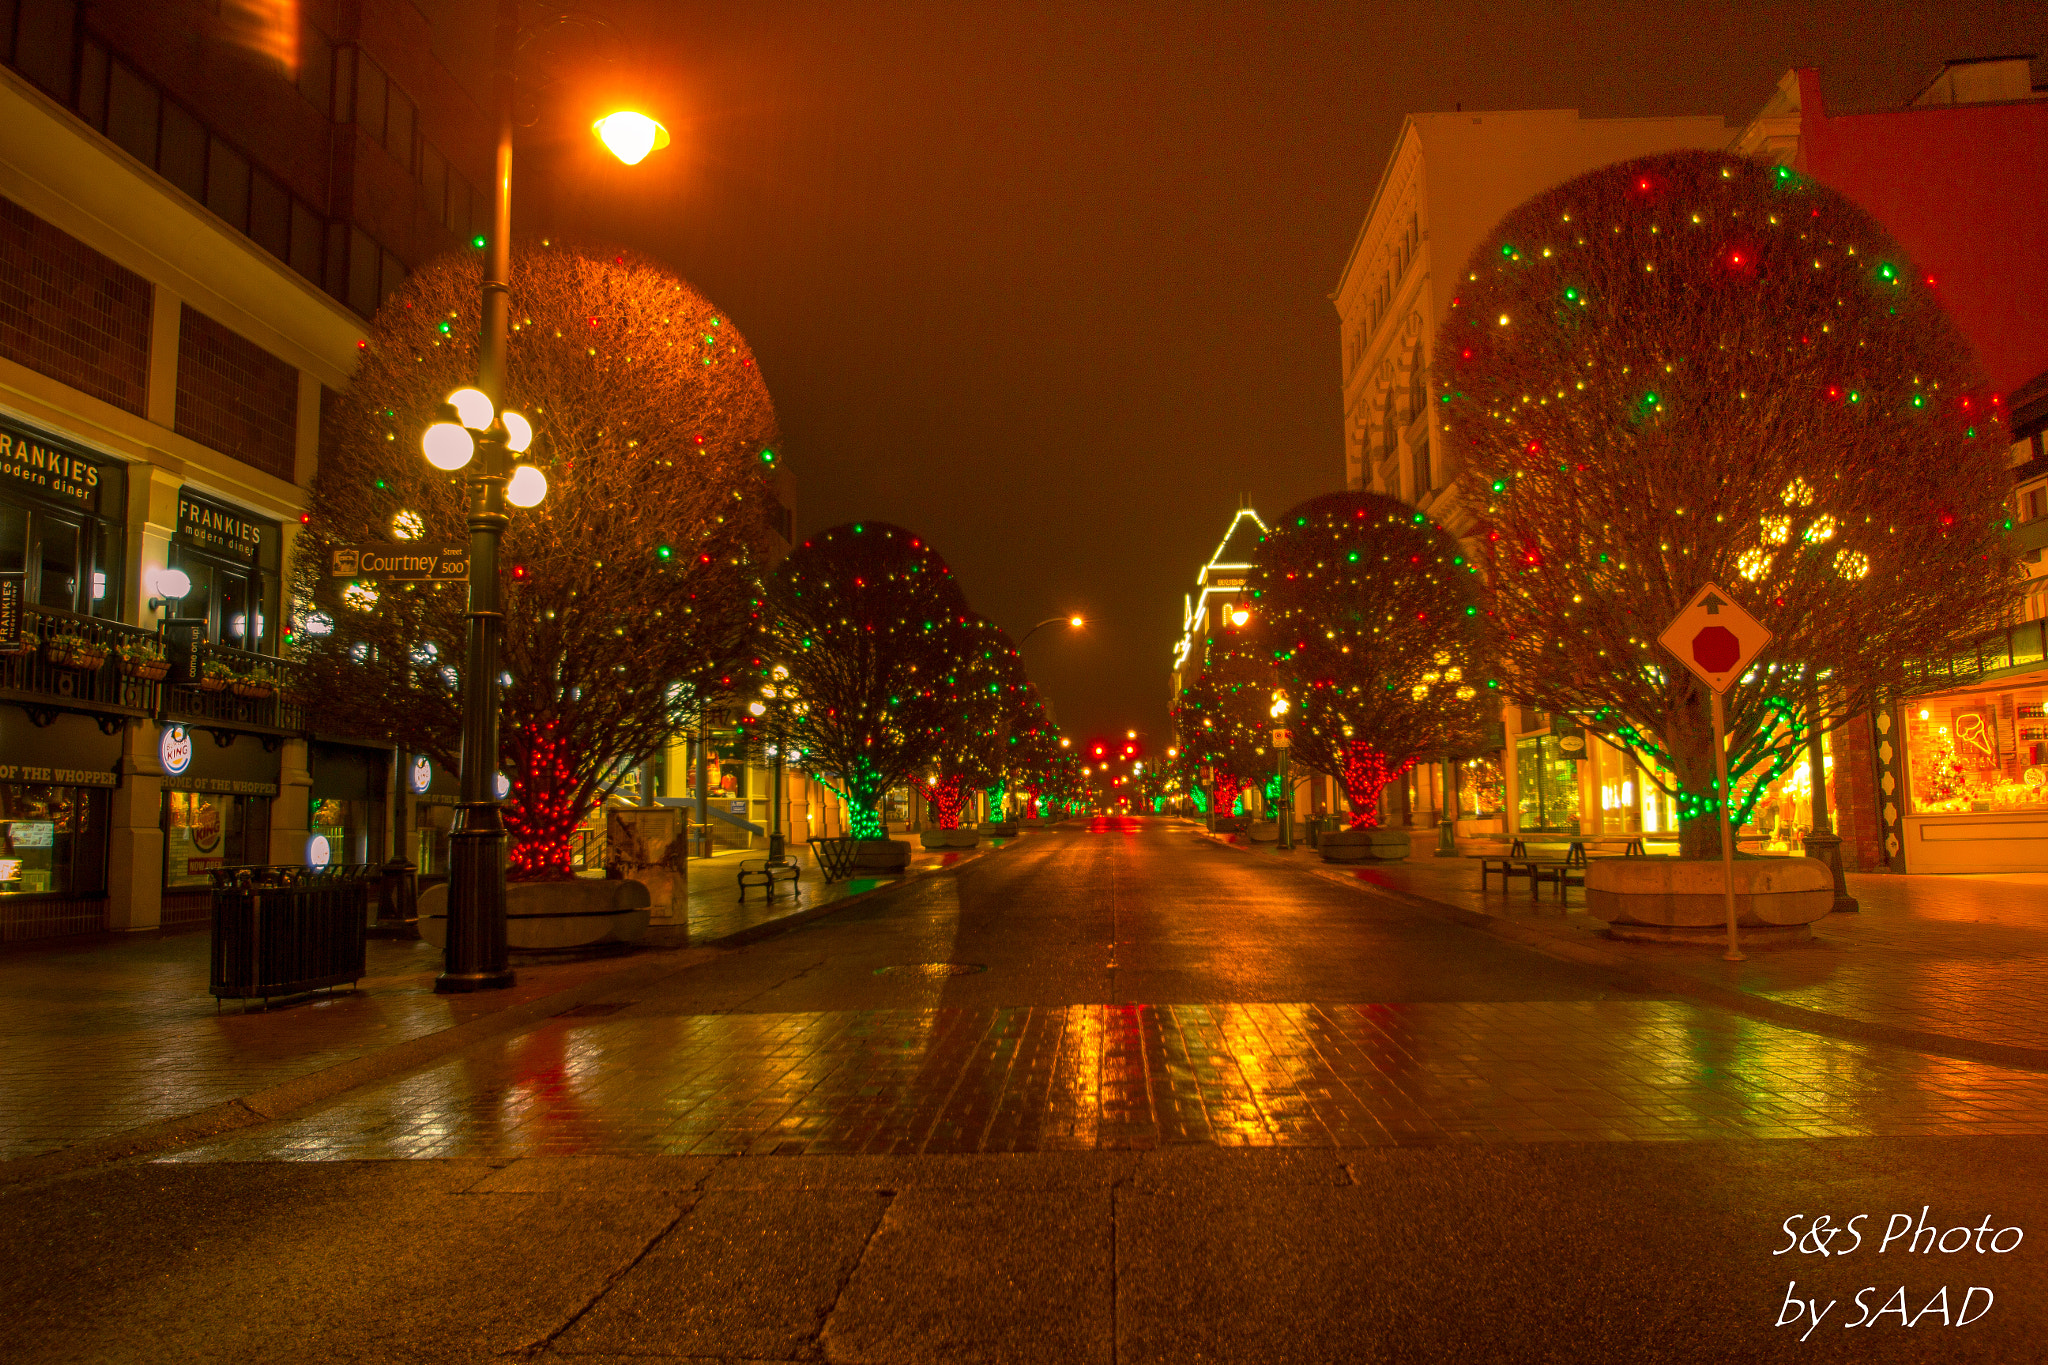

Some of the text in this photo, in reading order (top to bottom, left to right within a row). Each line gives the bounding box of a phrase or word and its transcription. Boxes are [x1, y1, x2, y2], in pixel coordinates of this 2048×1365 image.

[52, 479, 90, 500] diner
[180, 500, 261, 544] FRANKIE'S
[185, 525, 255, 556] modern diner
[443, 547, 463, 556] Street
[361, 552, 439, 574] Courtney
[441, 562, 464, 574] 500
[191, 641, 198, 653] on
[190, 654, 198, 678] come
[167, 744, 189, 761] KING
[0, 765, 117, 785] OF THE WHOPPER
[161, 776, 277, 794] HOME OF THE WHOPPER
[197, 821, 221, 840] KING
[189, 861, 205, 872] NOW
